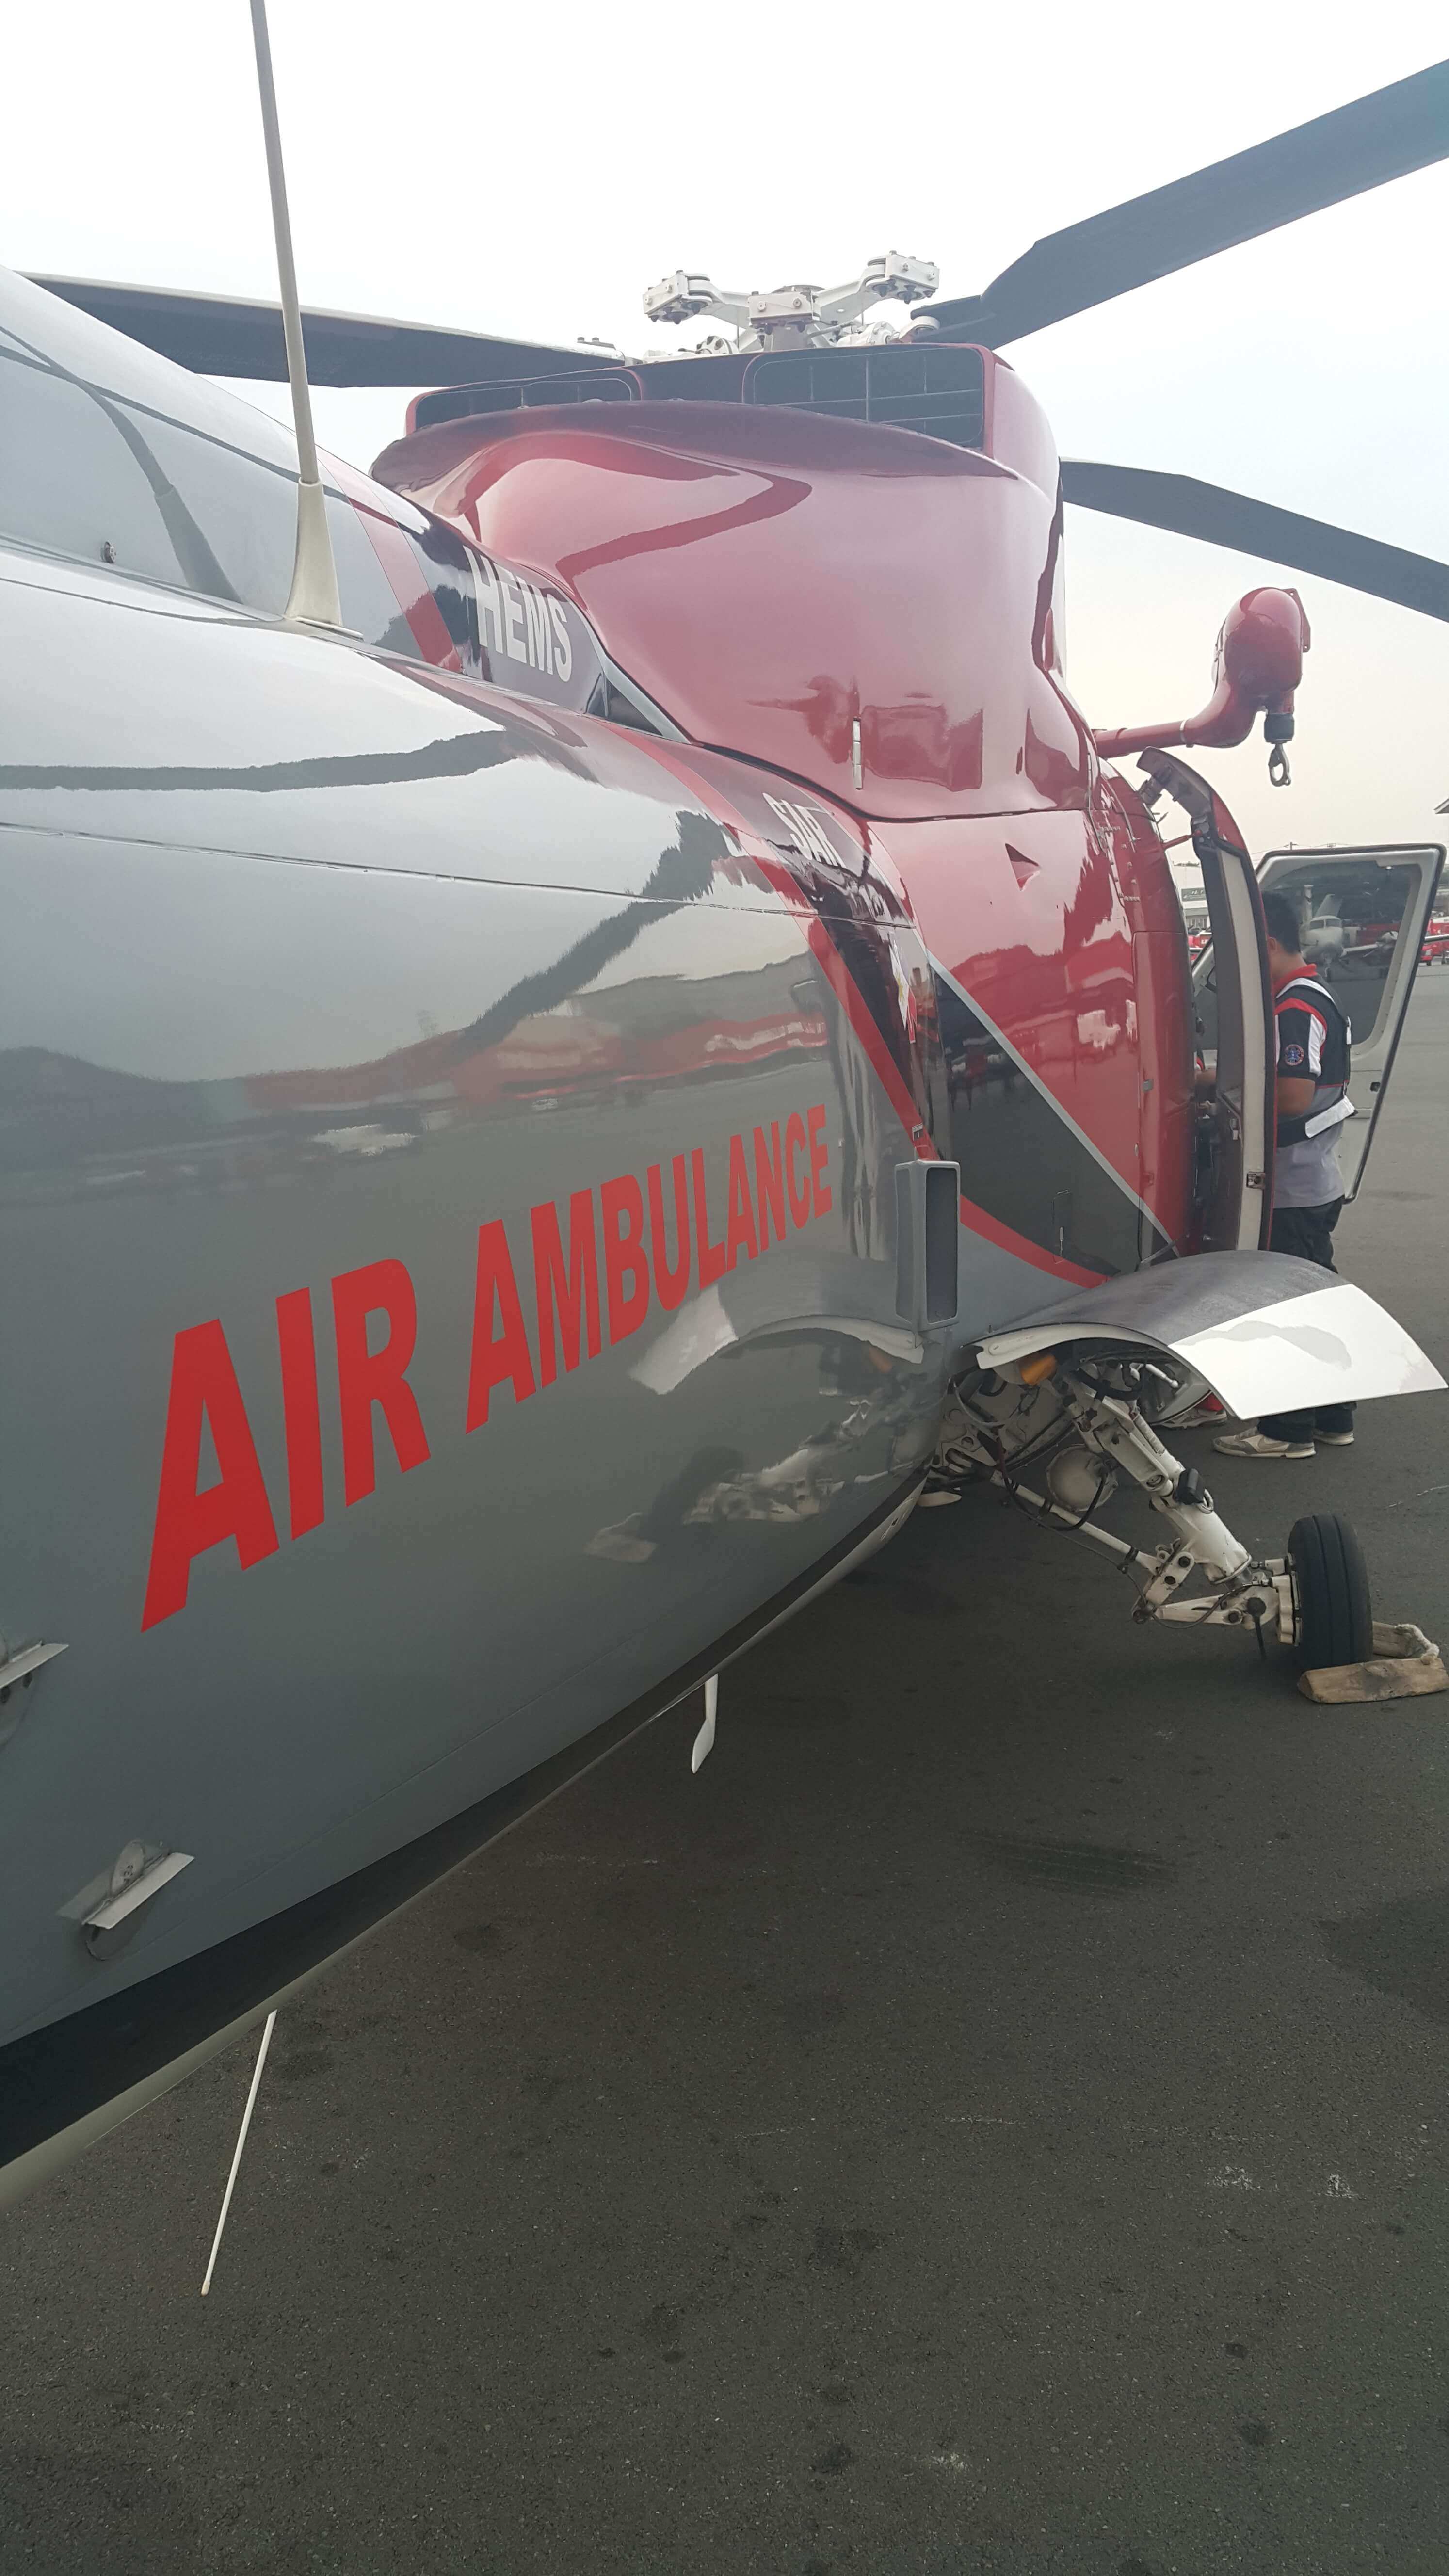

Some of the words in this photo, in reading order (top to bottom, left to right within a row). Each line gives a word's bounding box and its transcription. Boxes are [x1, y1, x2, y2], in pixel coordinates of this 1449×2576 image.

[462, 545, 572, 682] HEMS
[762, 792, 847, 869] SAR
[141, 1258, 431, 1632] AIR
[466, 1104, 832, 1434] AMBULANCE
